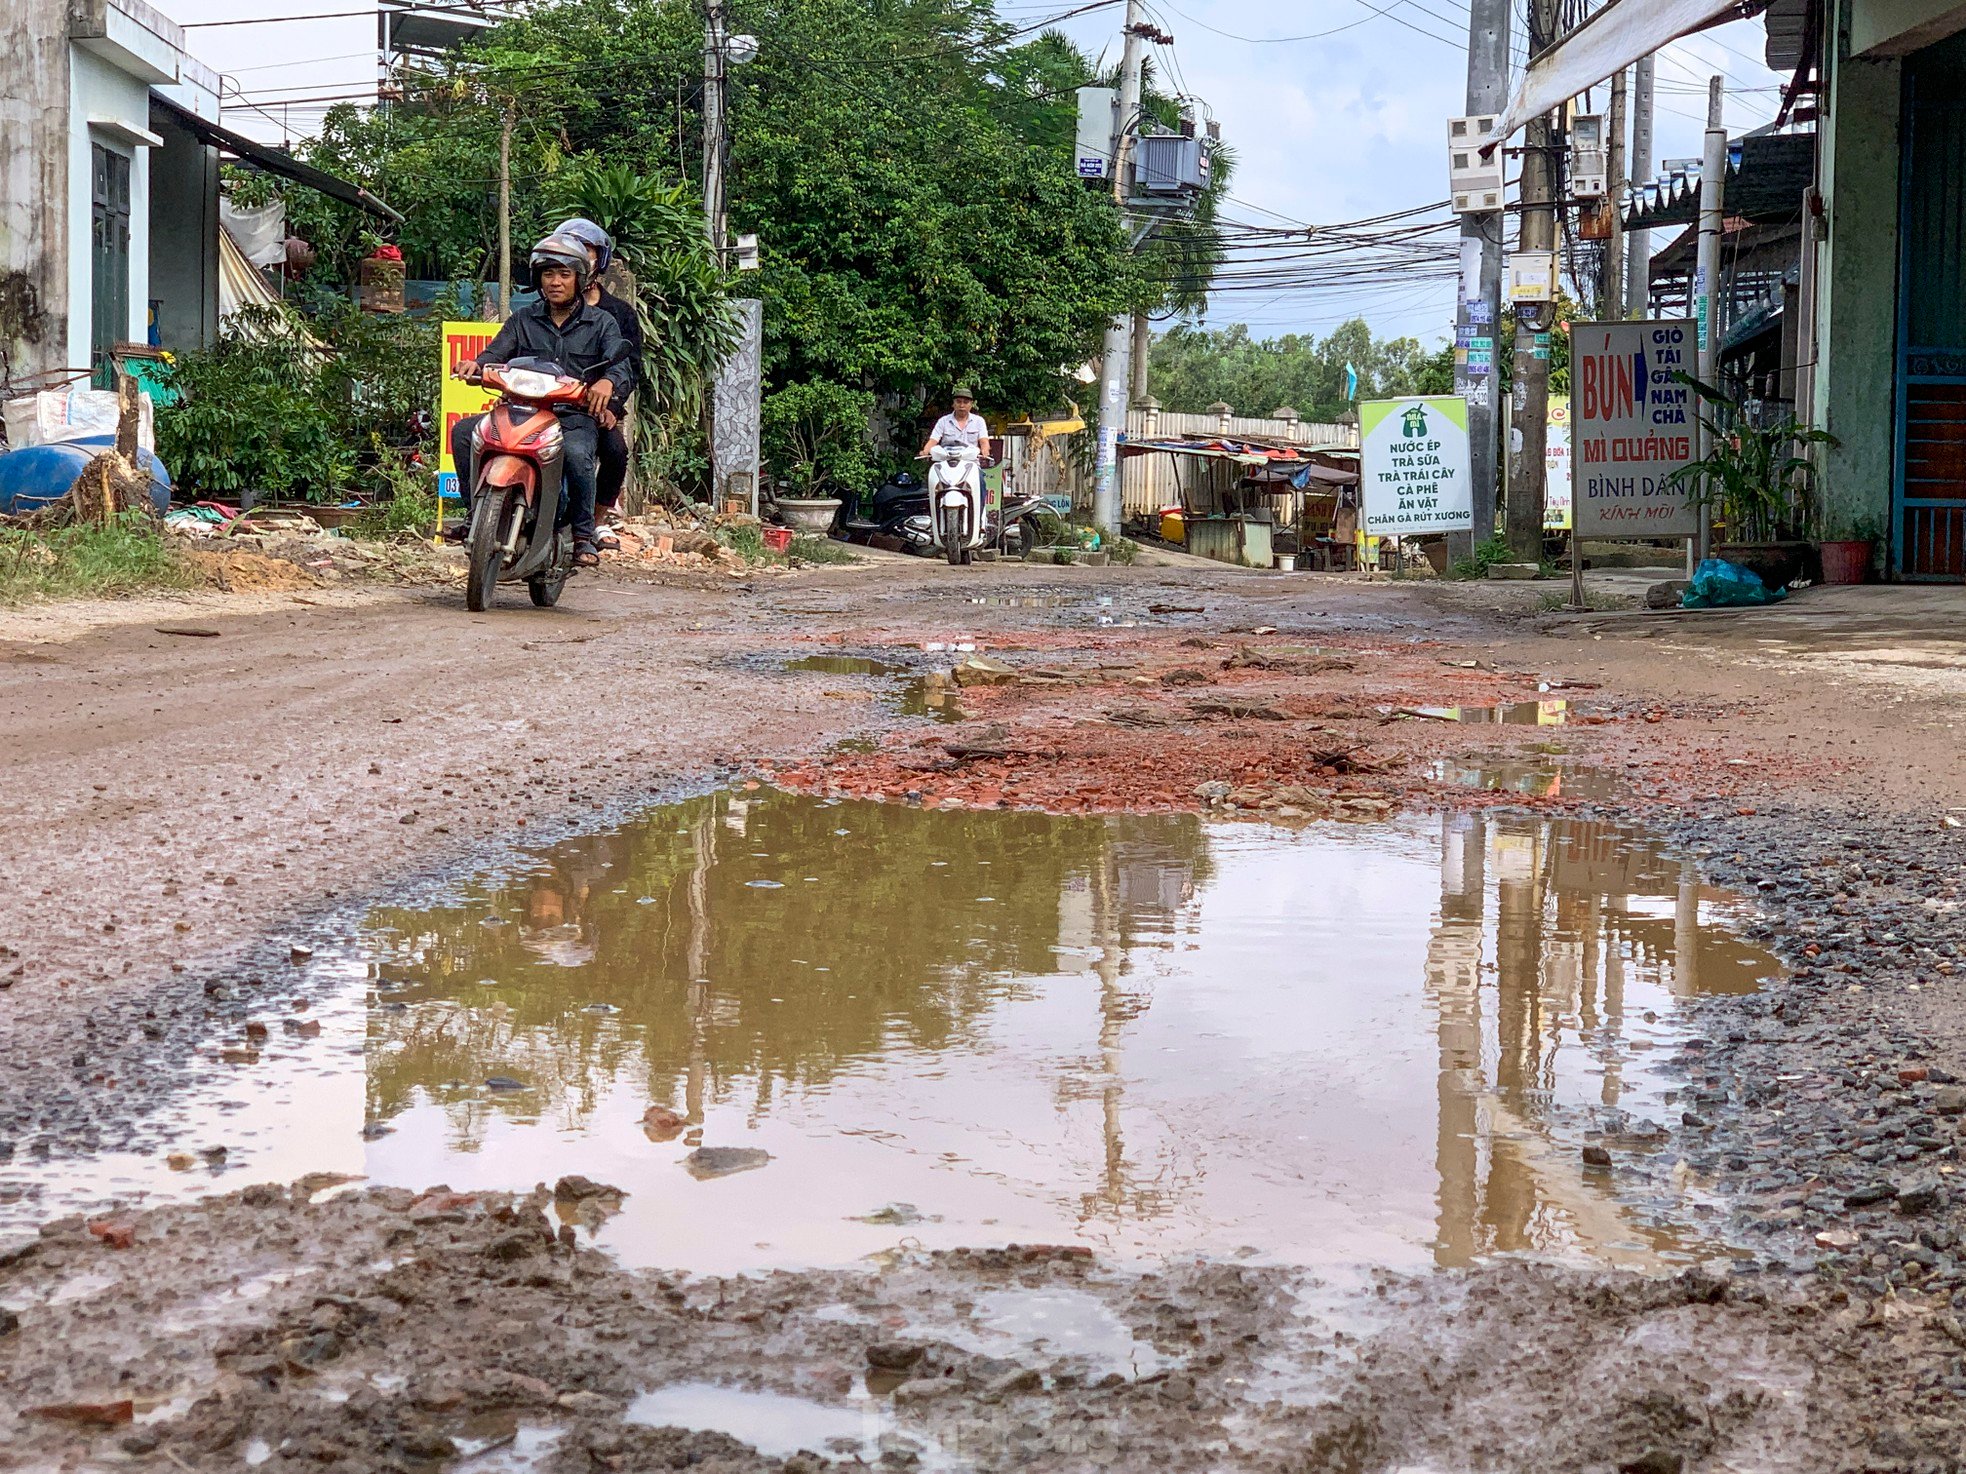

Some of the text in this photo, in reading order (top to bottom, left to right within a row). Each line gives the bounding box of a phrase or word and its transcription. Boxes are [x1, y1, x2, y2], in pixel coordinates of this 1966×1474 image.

[1652, 326, 1684, 345] GIÒ
[1656, 346, 1681, 364] TÁI
[1583, 333, 1633, 422] BÚN
[1652, 405, 1686, 424] CHẢ
[1390, 438, 1441, 454] NƯỚC ÉP
[1583, 430, 1689, 462] MÌ QUẢNG
[1392, 454, 1440, 467] TRÀ SỮA
[1378, 467, 1455, 482] TRÀ TRÁI CÂY
[1397, 482, 1439, 496] CÀ PHÊ
[1588, 473, 1685, 498] BÌNH DÂN
[1398, 496, 1438, 512] ĂN VẶT
[1367, 509, 1471, 525] CHÂN GÀ RÚT XƯƠNG
[1600, 505, 1641, 521] KÍNH
